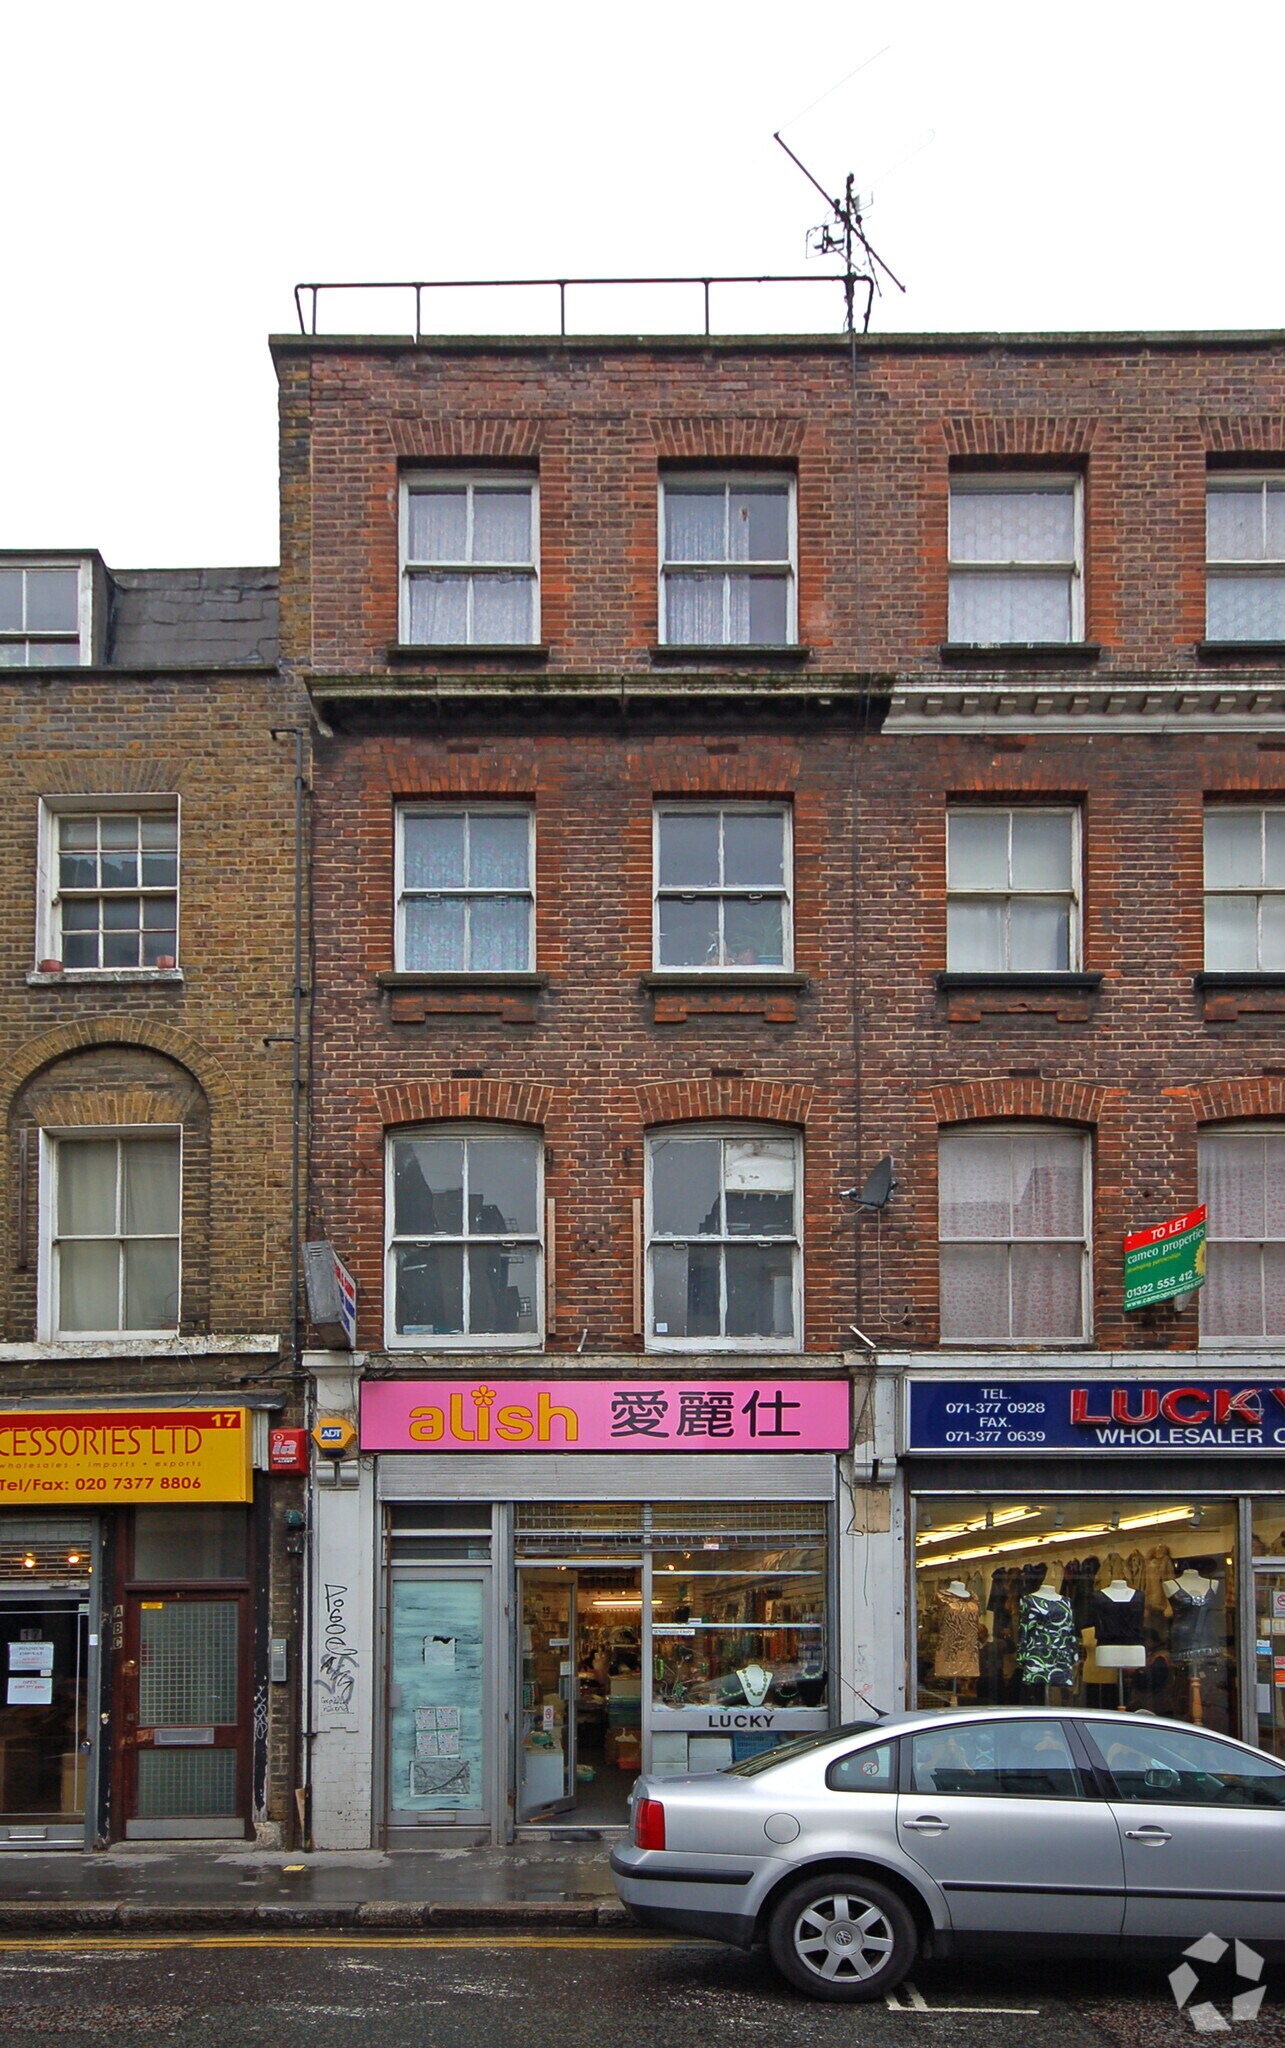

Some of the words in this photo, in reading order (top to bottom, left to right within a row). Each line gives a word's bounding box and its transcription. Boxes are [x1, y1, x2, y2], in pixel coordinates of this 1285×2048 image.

[1151, 1227, 1165, 1240] TO
[1169, 1217, 1188, 1233] LET
[1127, 1247, 1159, 1264] cameo
[1162, 1227, 1205, 1255] properties
[1126, 1282, 1154, 1299] 01322
[1157, 1276, 1176, 1290] 555
[1178, 1269, 1193, 1281] 412
[981, 1388, 1012, 1400] TEL.
[408, 1385, 579, 1442] alish
[610, 1390, 801, 1438] 愛麗仕
[945, 1402, 1001, 1414] 071-377
[1007, 1402, 1046, 1414] 0928
[211, 1413, 237, 1427] 17
[979, 1416, 1012, 1428] FAX.
[321, 1428, 342, 1438] ADT
[945, 1430, 1001, 1442] 071-377
[1007, 1430, 1046, 1442] 0639
[1096, 1427, 1263, 1445] WHOLESALER
[152, 1426, 203, 1455] LTD
[88, 1460, 135, 1469] imports
[155, 1460, 202, 1469] exports
[0, 1478, 70, 1492] Tel/Fax:
[75, 1478, 107, 1490] 020
[113, 1478, 154, 1490] 7377
[160, 1477, 202, 1490] 8806
[114, 1606, 122, 1617] A
[114, 1623, 121, 1633] B
[114, 1638, 121, 1648] C
[708, 1714, 775, 1728] LUCKY
